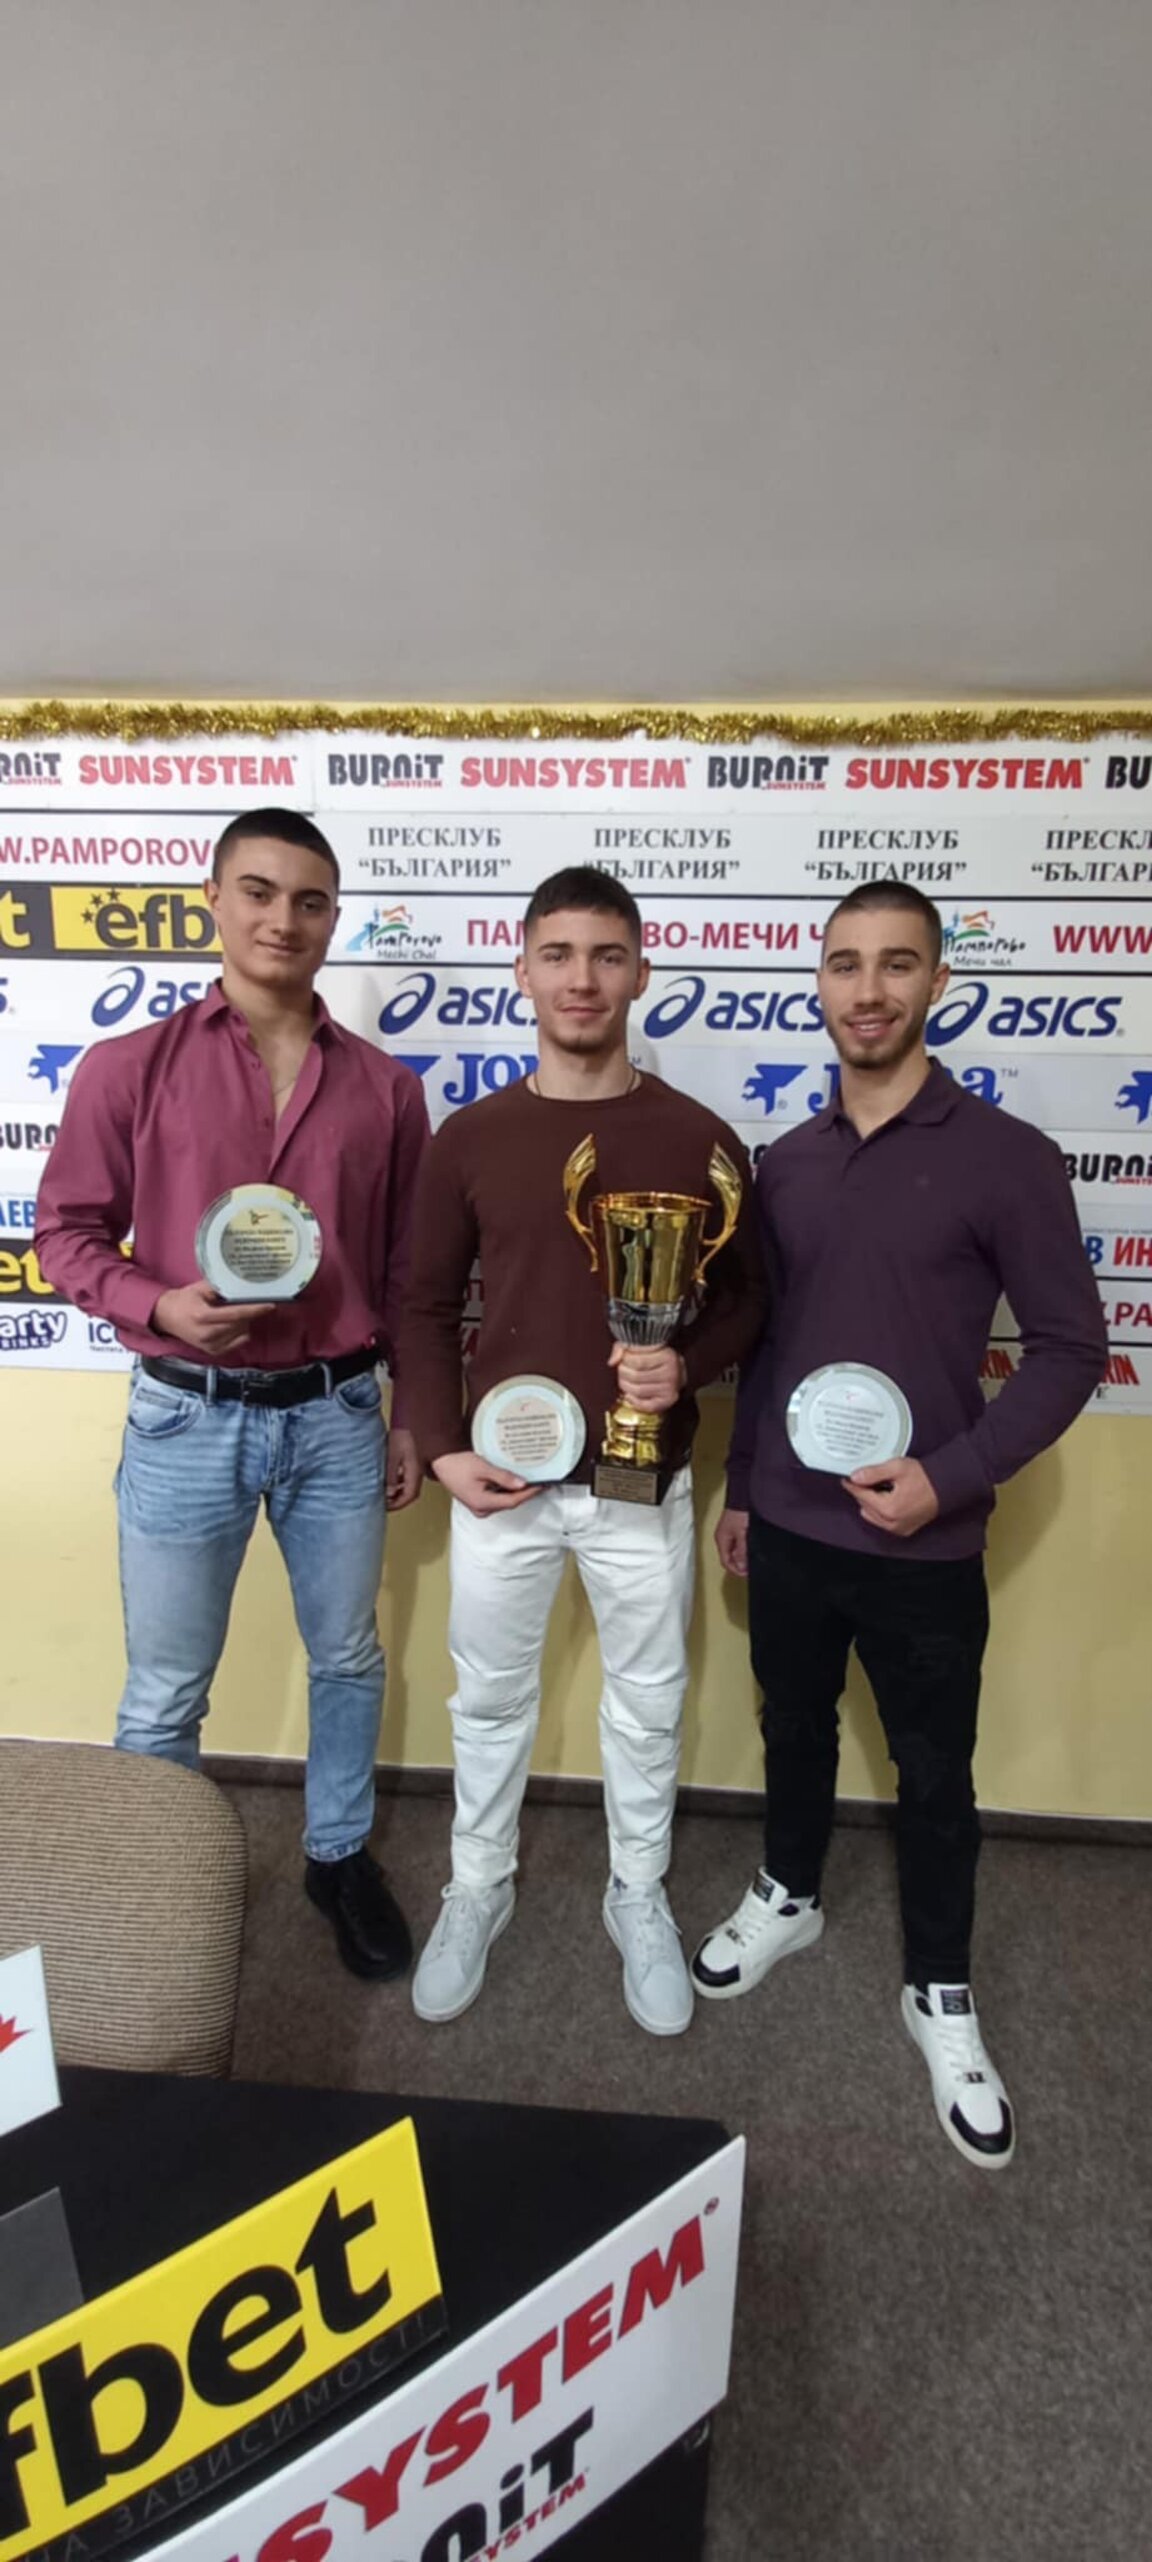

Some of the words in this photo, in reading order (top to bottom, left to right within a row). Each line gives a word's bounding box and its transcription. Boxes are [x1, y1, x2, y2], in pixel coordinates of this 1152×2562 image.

[79, 755, 294, 786] SUNSYSTEM
[461, 757, 686, 789] SUNSYSTEM
[845, 758, 1083, 790] SUNSYSTEM
[368, 827, 502, 849] ПРЕСКЛУБ
[594, 828, 731, 850] ПРЕСКЛУБ
[817, 829, 960, 851] ПРЕСКЛУБ
[224, 2215, 706, 2562] SYSTEM
